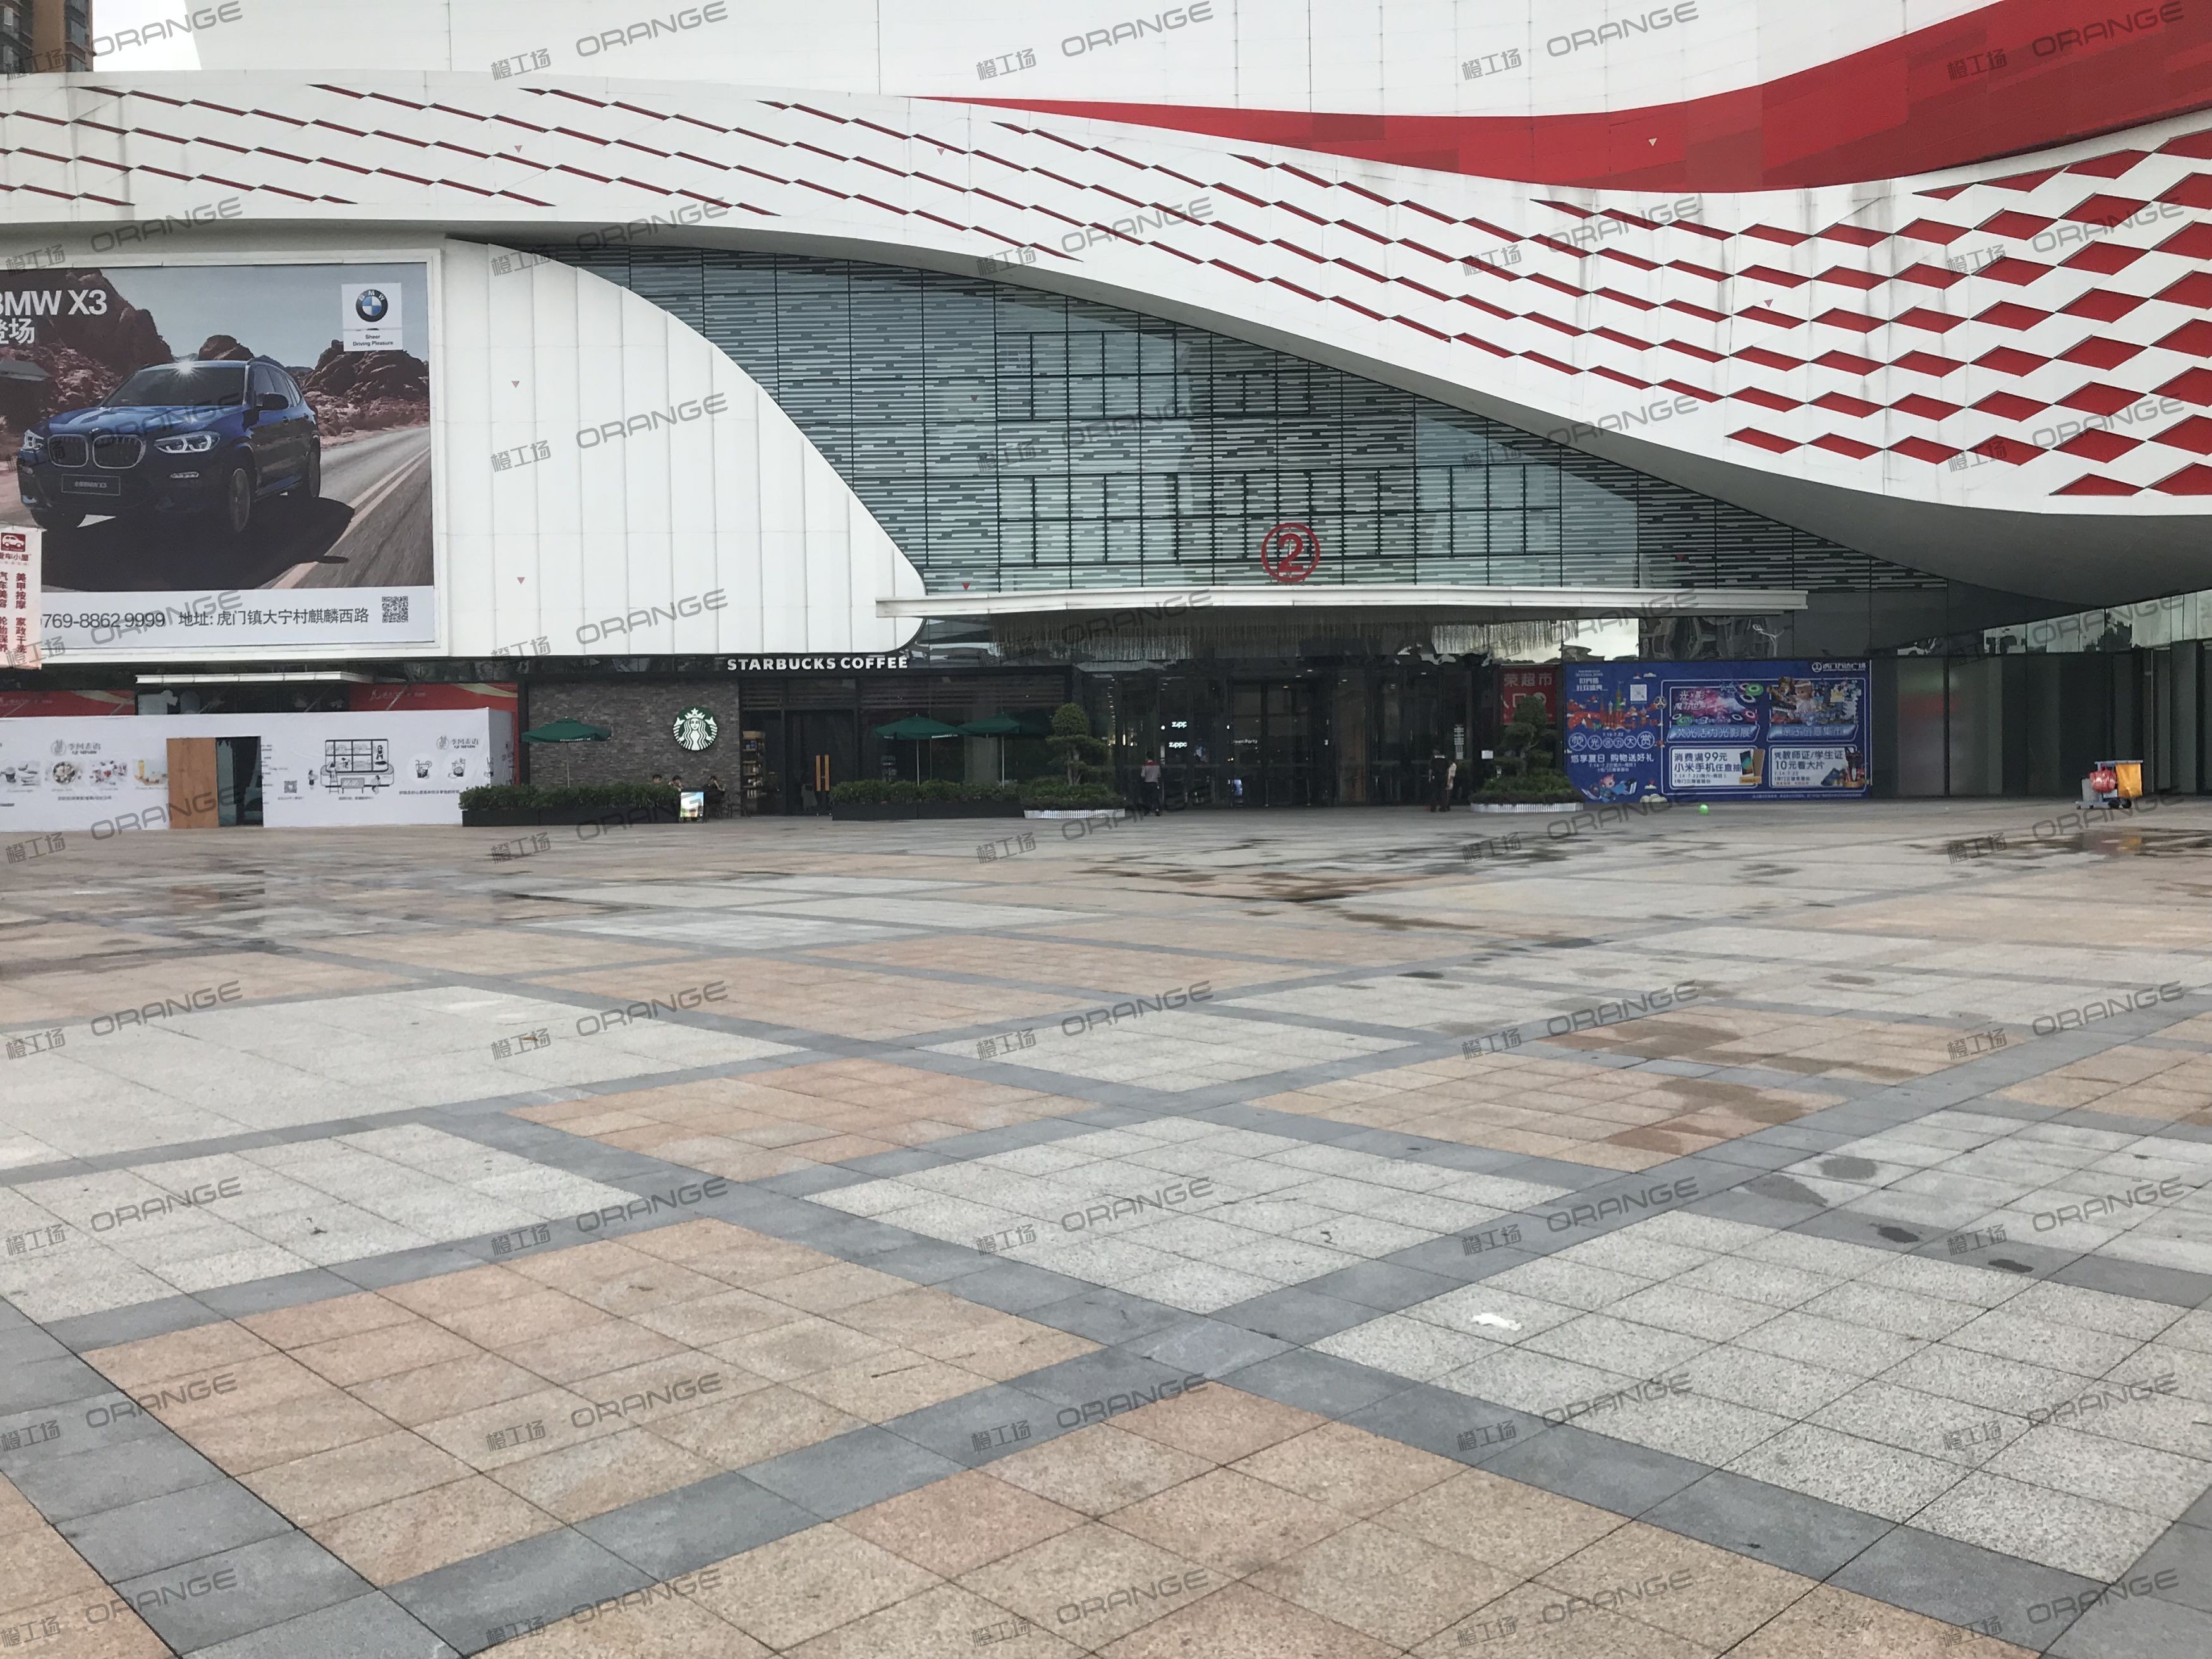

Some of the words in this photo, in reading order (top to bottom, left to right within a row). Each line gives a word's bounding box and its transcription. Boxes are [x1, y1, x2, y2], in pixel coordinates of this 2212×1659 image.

[0, 290, 62, 315] MW
[68, 289, 107, 315] X3
[359, 290, 385, 301] BMW
[16, 573, 27, 609] 美甲按摩
[40, 612, 120, 628] 769-8862
[216, 607, 369, 626] 虎门镇大宁村麒麟西路
[16, 617, 27, 653] 家政干洗
[727, 657, 836, 671] STARBUCKS
[841, 656, 908, 670] COFFEE
[1504, 672, 1552, 687] 荣超市
[1610, 753, 1655, 762] 购物送好礼
[1675, 752, 1728, 762] 消费满99元
[1774, 750, 1843, 760] 凭教师证/学生证
[1675, 762, 1742, 772] 小米手机任意抽
[1775, 760, 1825, 770] 10元看大片
